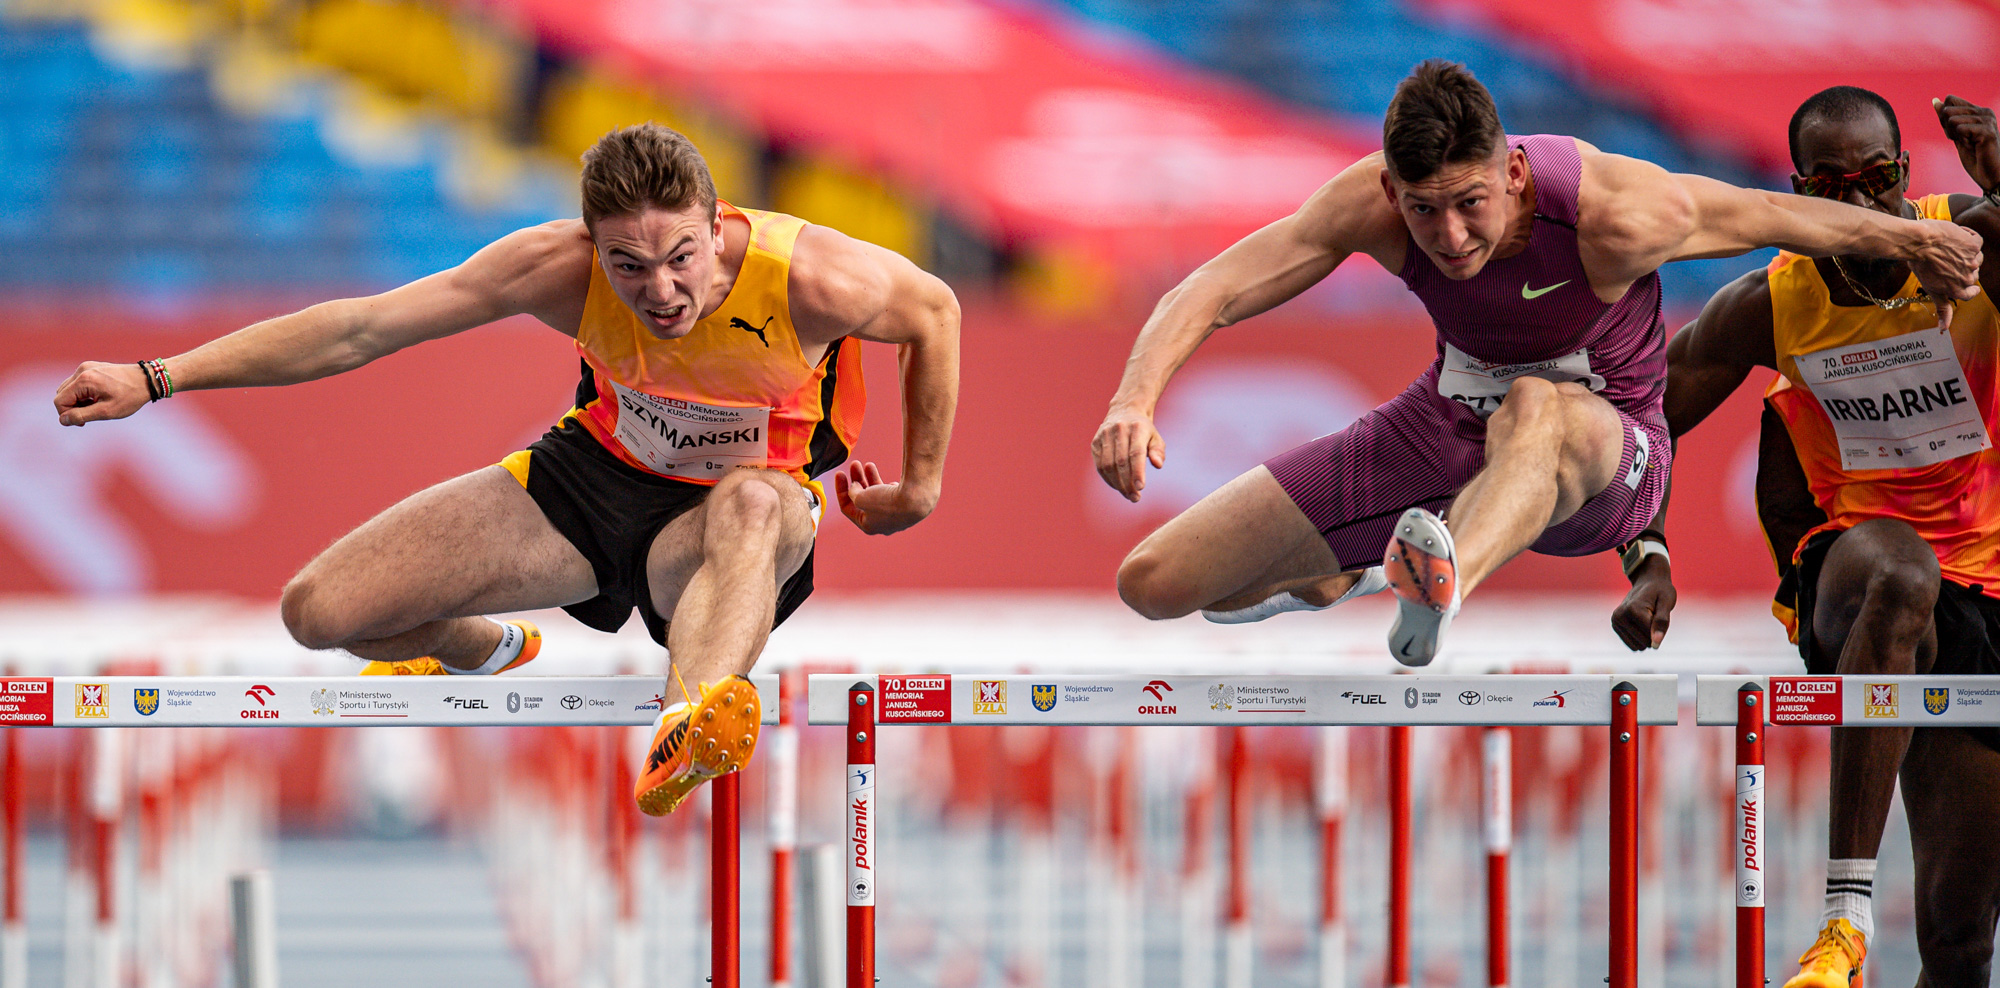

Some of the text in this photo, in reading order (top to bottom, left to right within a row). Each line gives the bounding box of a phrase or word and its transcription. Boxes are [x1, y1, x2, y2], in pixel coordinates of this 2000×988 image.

[1822, 340, 1927, 369] 70. ORLEN MEMORIAŁ
[1823, 350, 1932, 380] JANUSZA KUSOCIŃSKIEGO
[1823, 378, 1967, 422] IRIBARNE
[650, 395, 686, 409] ORLEN
[690, 404, 741, 417] MEMORIAŁ
[667, 408, 744, 422] KUSOCIŃSKIEGO
[621, 394, 759, 449] SZYMAŃSKI
[10, 683, 44, 692] ORLEN
[885, 679, 942, 691] 70. ORLEN
[1064, 685, 1114, 694] Województwo
[1775, 682, 1833, 694] 70. ORLEN
[167, 689, 216, 697] Województwo
[1237, 686, 1289, 694] Ministerstwo
[1956, 688, 2000, 697] Województw
[0, 695, 26, 703] MORIAŁ
[339, 691, 392, 699] Ministerstwo
[1064, 694, 1090, 703] Śląskie
[1352, 694, 1387, 704] FUEL
[1487, 695, 1513, 703] Okęcie
[1776, 695, 1815, 703] MEMORIAŁ
[167, 698, 192, 707] Śląskie
[454, 699, 489, 709] FUEL
[588, 698, 615, 707] Okęcie
[1237, 696, 1264, 705] Sportu
[1271, 696, 1307, 705] Turystyki
[1956, 697, 1982, 706] Śląskie
[339, 701, 366, 710] Sportu
[373, 701, 409, 710] Turystyki
[975, 704, 1004, 713] PZLA
[77, 706, 107, 717] PZLA
[240, 710, 279, 719] ORLEN
[885, 709, 944, 718] KUSOCIŃSKIEGO
[1138, 706, 1176, 715] ORLEN
[1866, 707, 1896, 716] PZLA
[0, 712, 47, 721] OCIŃSKIEGO
[1776, 712, 1836, 721] KUSOCIŃSKIEGO
[852, 798, 870, 870] polanik
[1741, 799, 1760, 871] polanik
